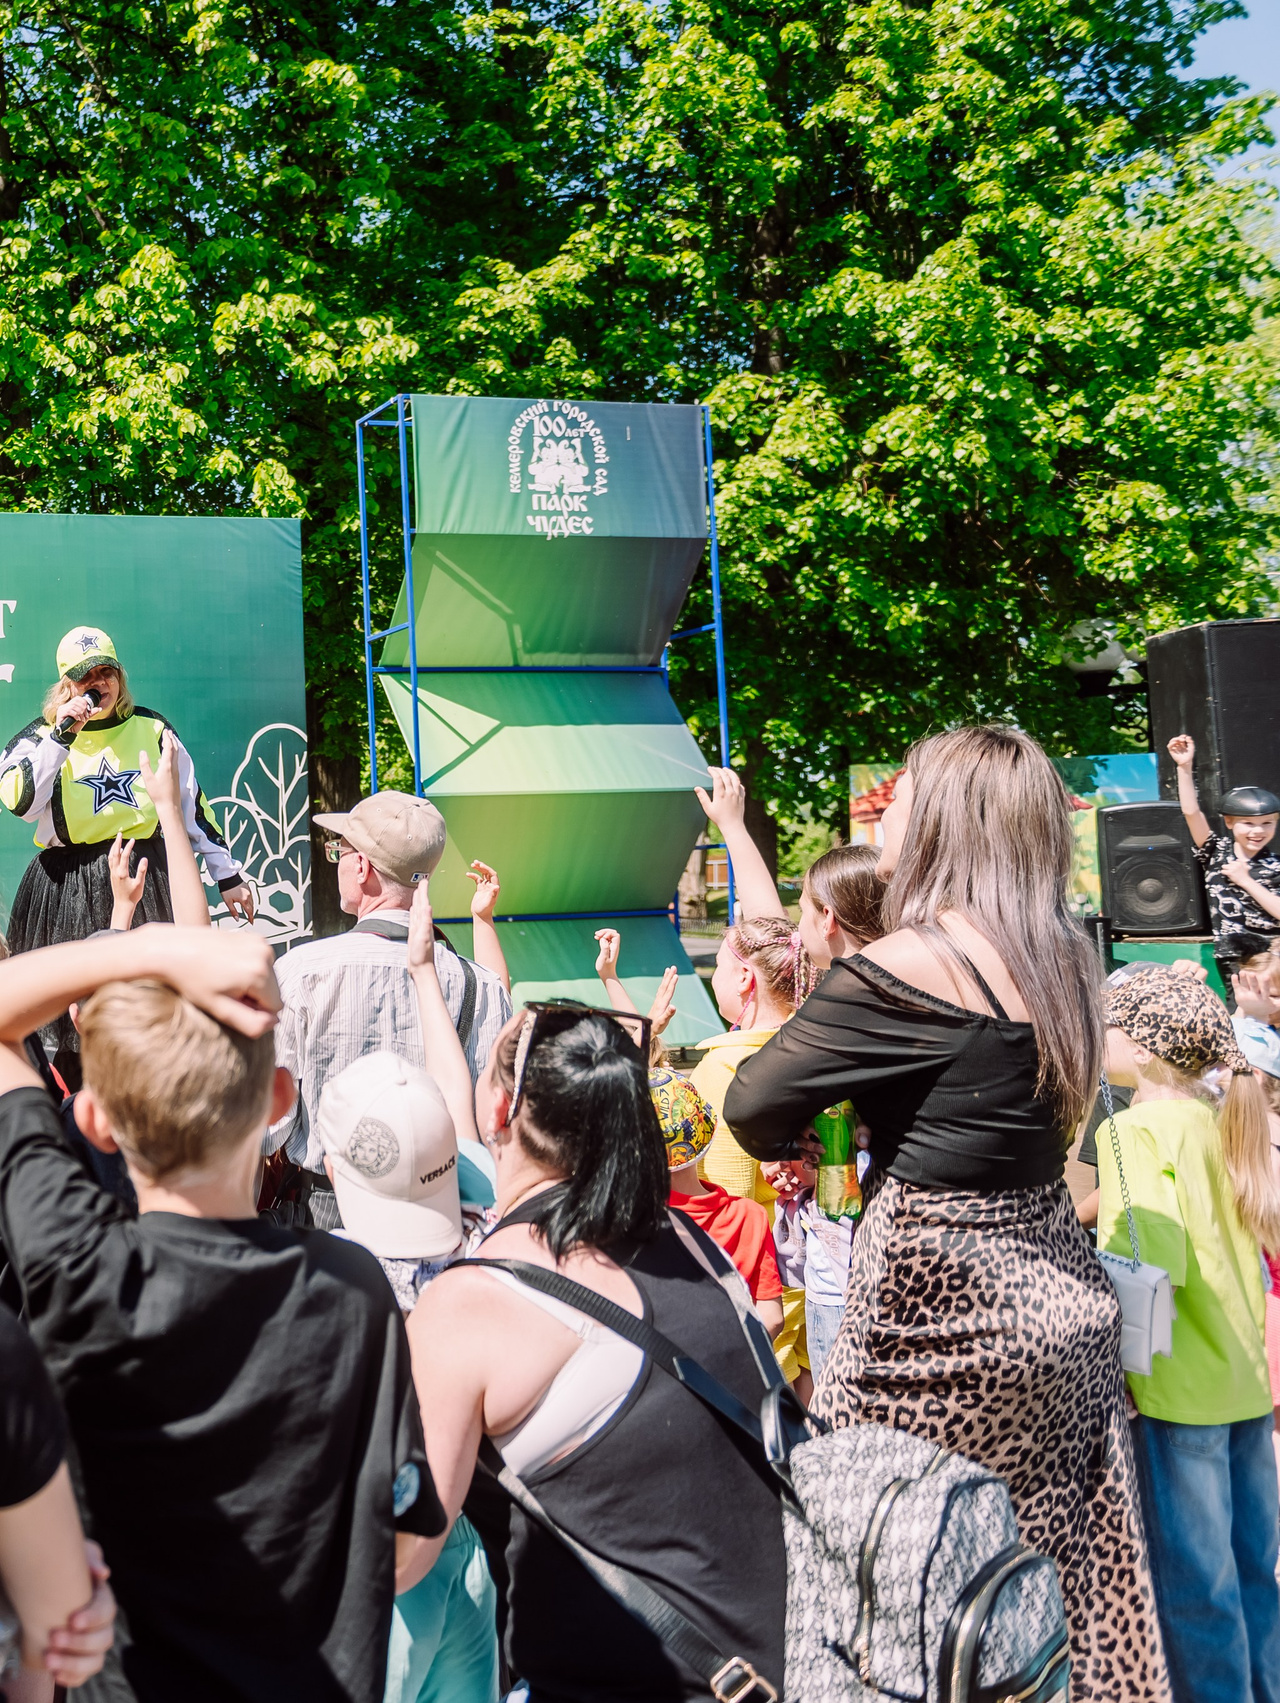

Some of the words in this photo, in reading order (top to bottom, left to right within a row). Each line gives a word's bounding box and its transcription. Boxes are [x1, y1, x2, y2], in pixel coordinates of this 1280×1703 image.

[532, 415, 566, 437] 100
[531, 494, 588, 519] ПАРК
[526, 515, 594, 541] ЧУДЕС
[419, 1154, 456, 1185] VERSACE
